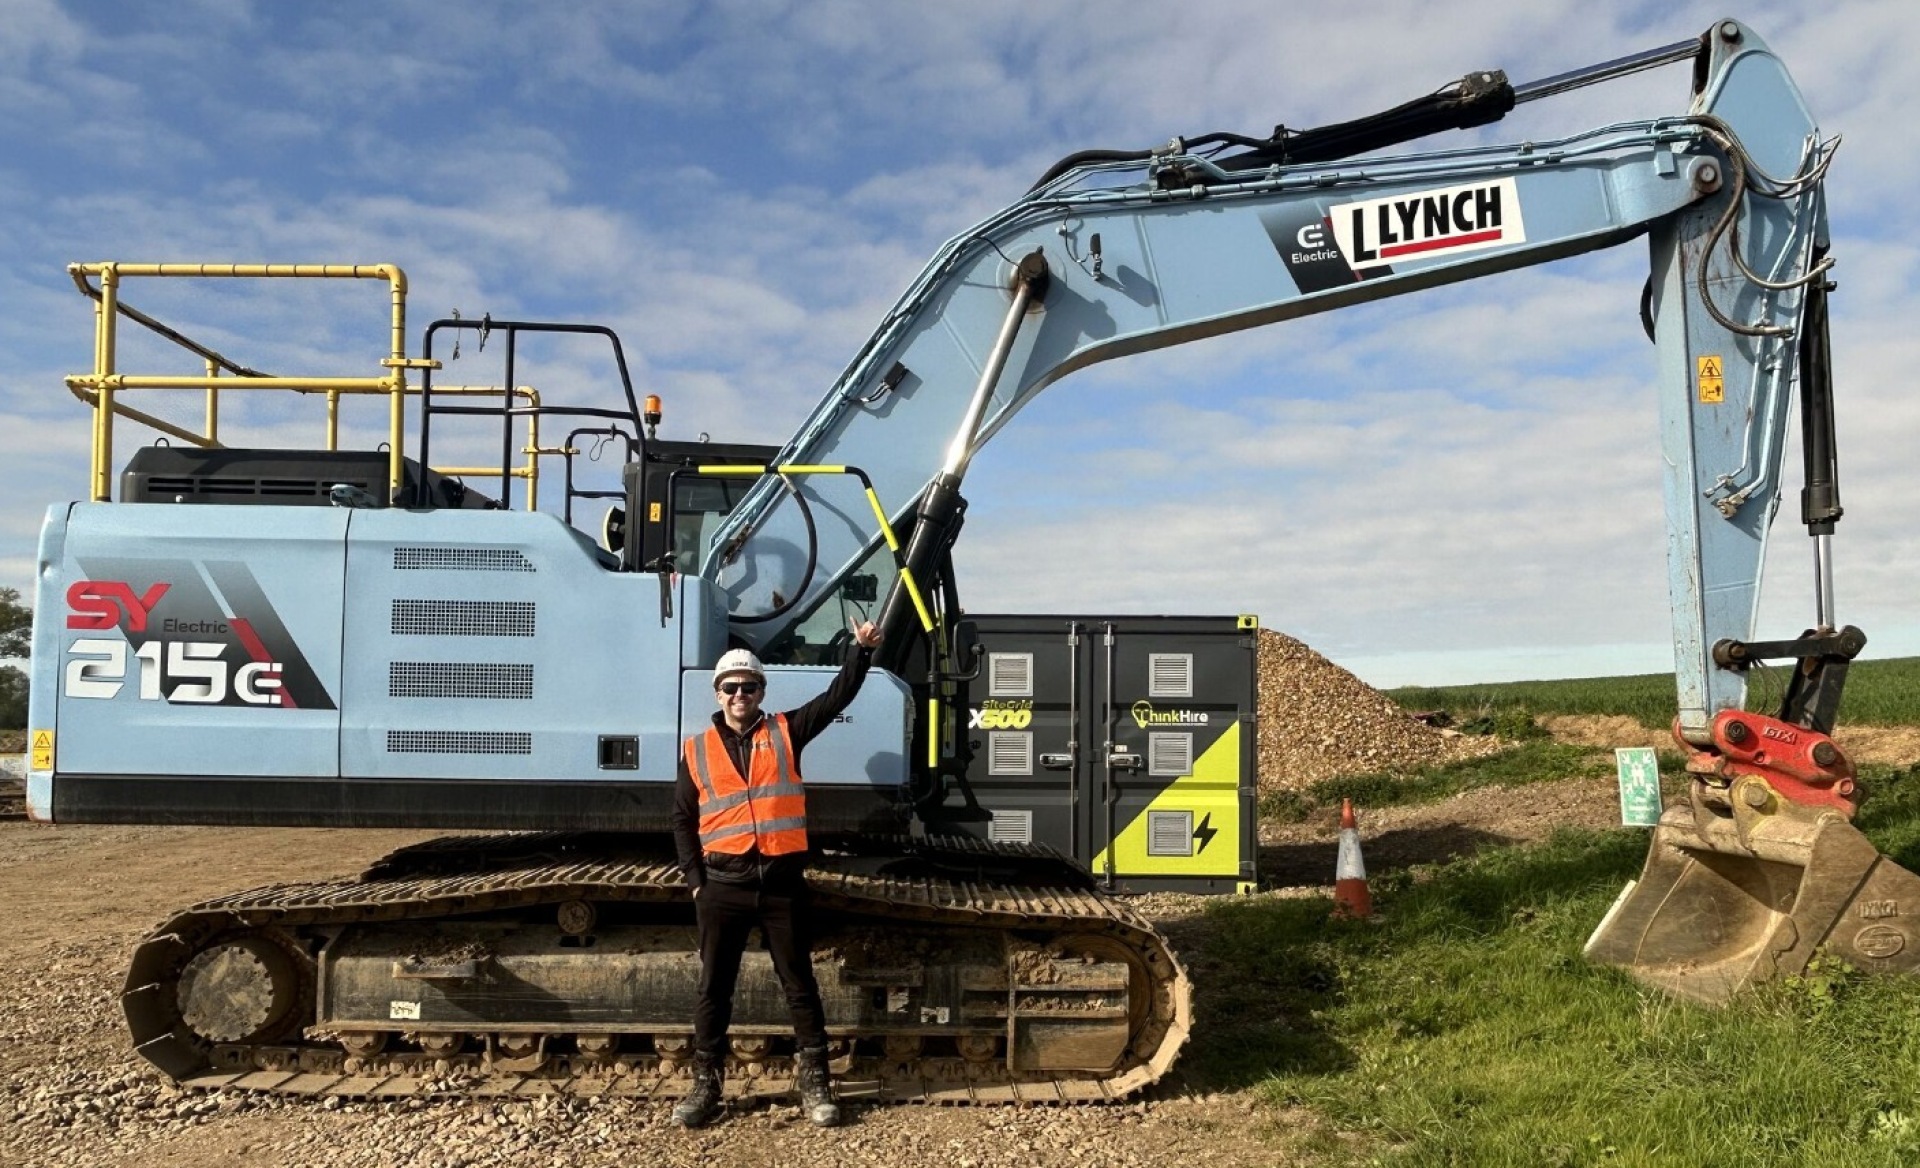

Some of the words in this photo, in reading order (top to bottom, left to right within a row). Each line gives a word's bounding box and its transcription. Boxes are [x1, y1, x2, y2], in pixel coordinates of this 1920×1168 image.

[1291, 249, 1338, 264] Electric
[66, 580, 172, 631] SY
[163, 618, 228, 634] Electric
[982, 699, 1034, 709] SiteGrid
[968, 708, 1033, 730] X500
[1132, 705, 1209, 725] ThinkHire
